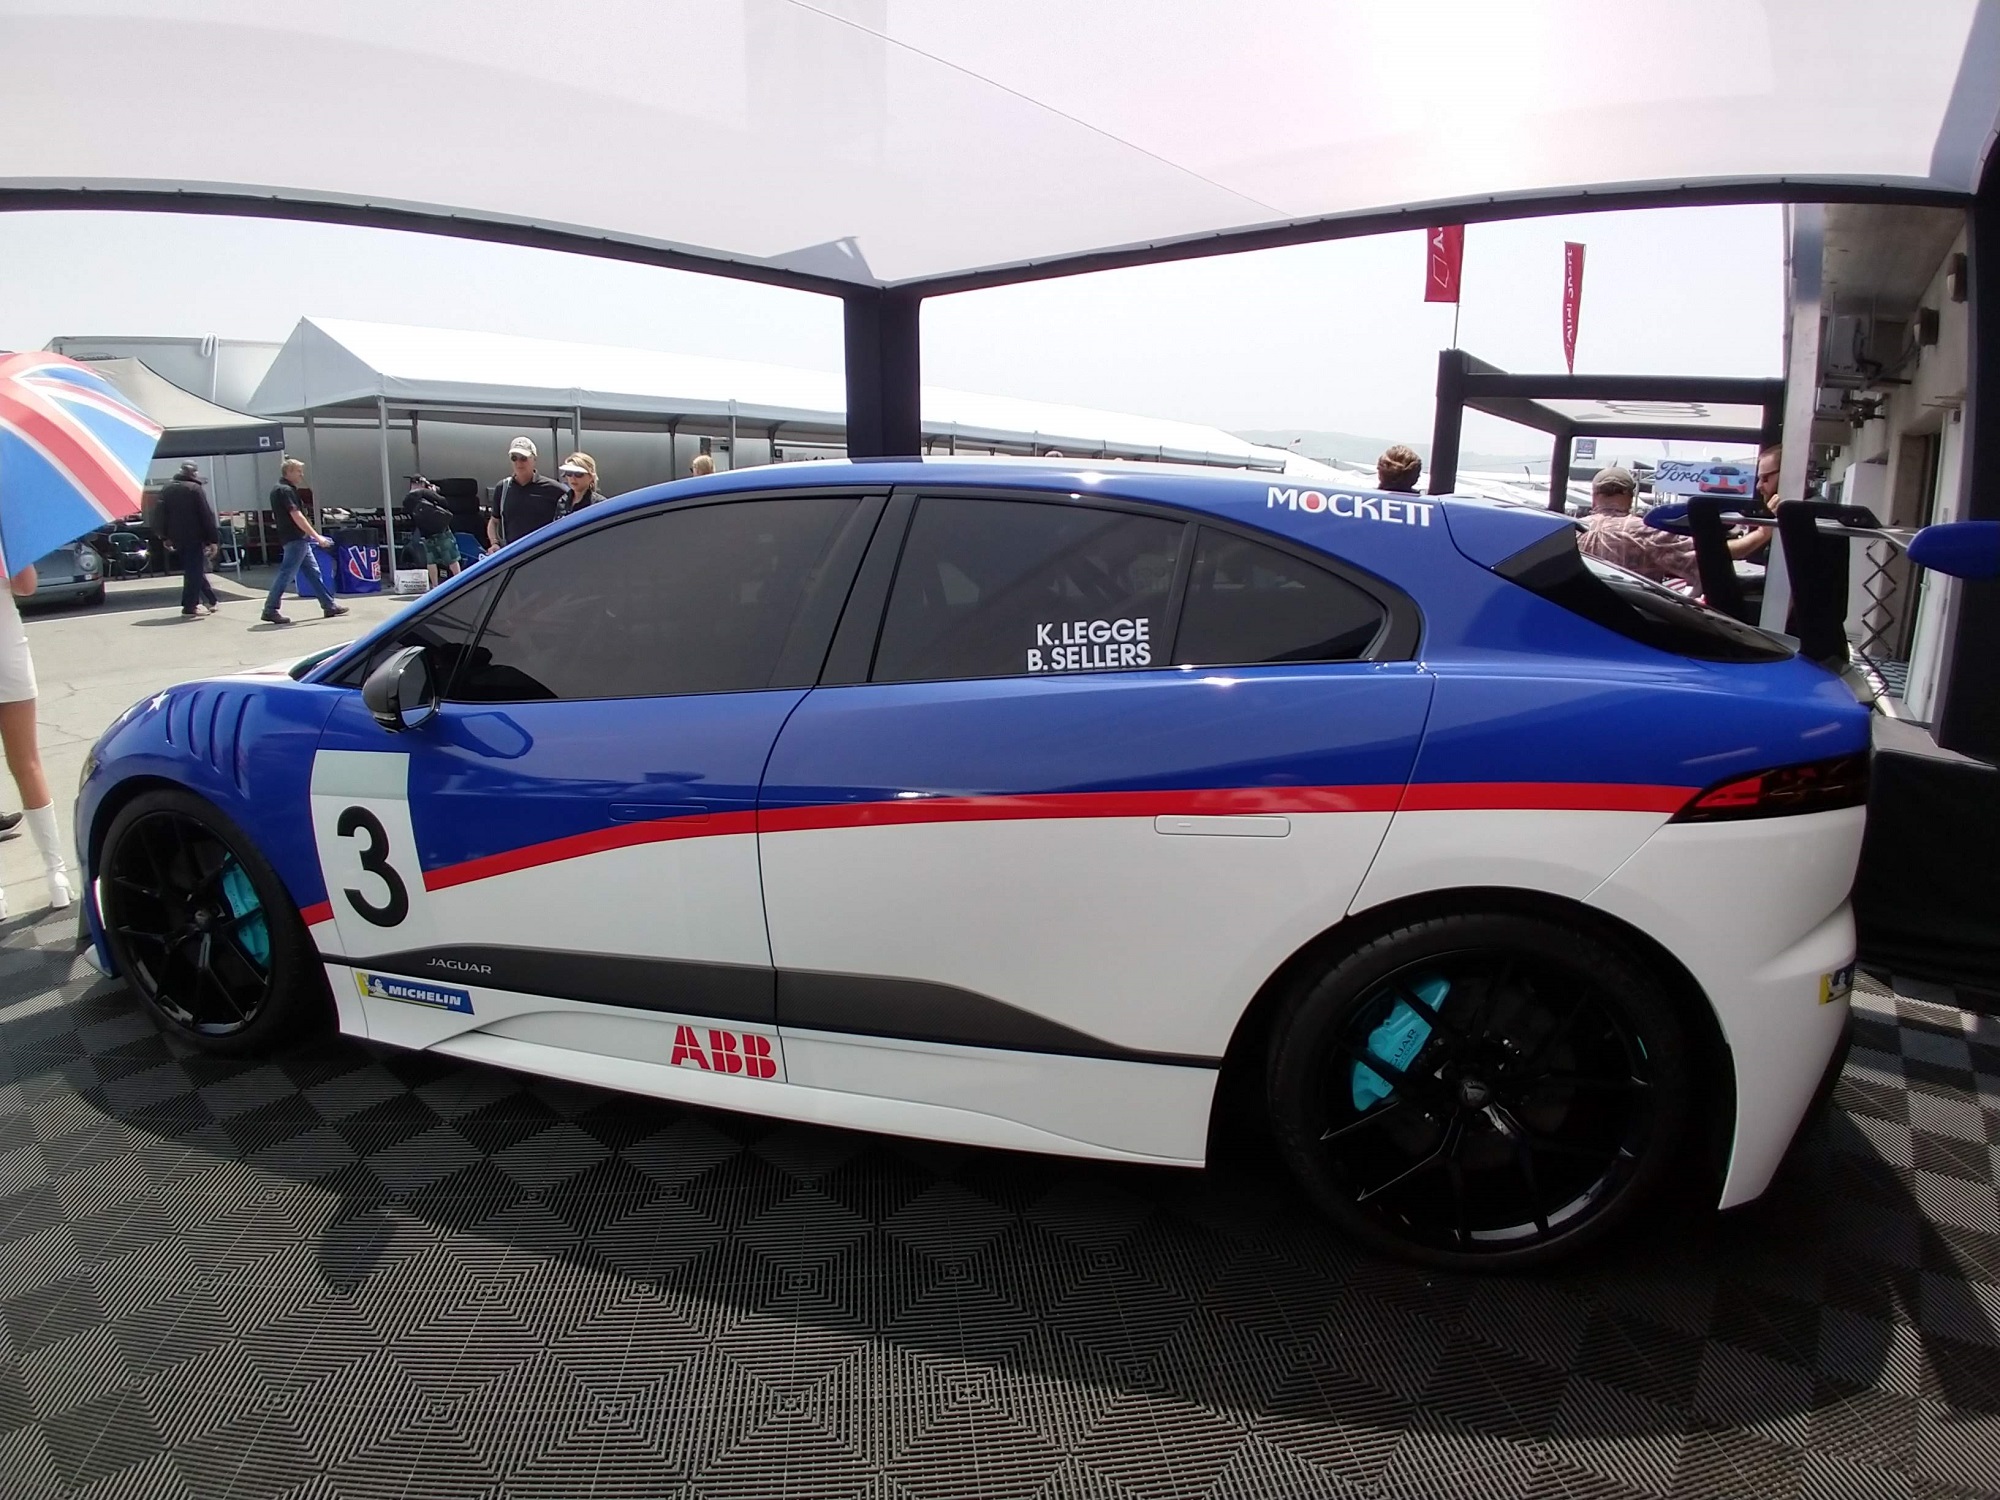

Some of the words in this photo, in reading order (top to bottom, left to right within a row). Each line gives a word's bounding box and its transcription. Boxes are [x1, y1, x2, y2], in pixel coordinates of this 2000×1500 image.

[1655, 460, 1706, 483] Ford
[1267, 486, 1435, 527] MOCKETT
[336, 805, 410, 928] 3
[426, 956, 493, 975] JAGUAR
[388, 985, 462, 1006] MICHELIN
[670, 1025, 778, 1079] ABB
